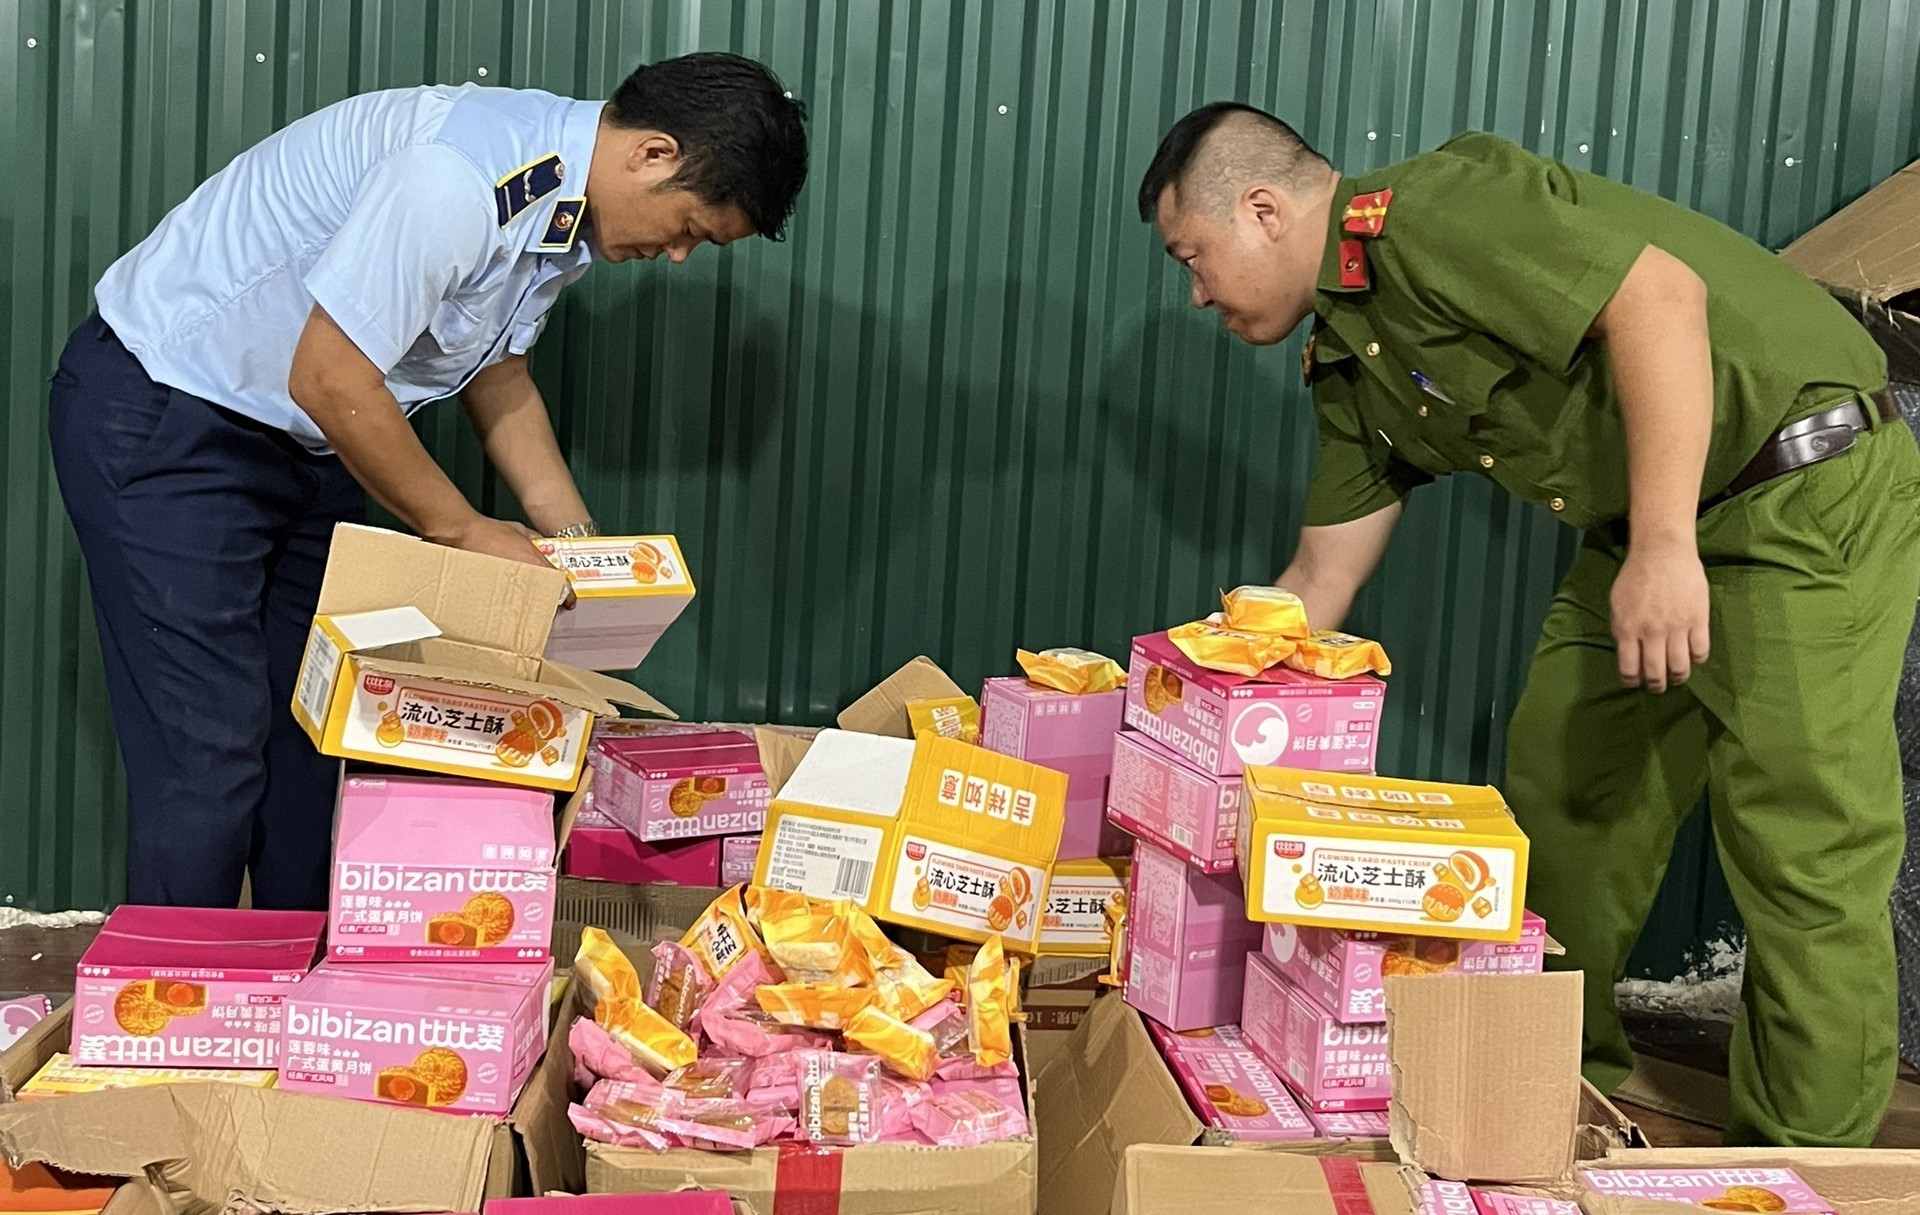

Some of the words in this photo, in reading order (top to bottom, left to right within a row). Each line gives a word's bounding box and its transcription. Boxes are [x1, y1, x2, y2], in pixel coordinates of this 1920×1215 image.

[566, 555, 630, 568] 流心芝士酥
[401, 701, 505, 735] 流心芝士酥
[464, 702, 487, 711] PASTE
[489, 705, 512, 714] CRISP
[1163, 717, 1218, 774] bibizan
[941, 774, 1031, 821] 吉祥如意
[1318, 853, 1355, 863] FLOWING
[1381, 858, 1406, 866] PASTE
[1408, 860, 1432, 868] CRISP
[340, 863, 464, 893] bibizan
[929, 867, 996, 900] 流心芝士酥
[1317, 863, 1427, 889] 流心芝士酥
[338, 909, 423, 924] 广式蛋黄月饼
[287, 1004, 414, 1045] bibizan
[419, 1017, 505, 1053] 比比赞
[171, 1036, 280, 1065] ibizan
[287, 1056, 372, 1077] 广式蛋黄月饼
[1586, 1171, 1714, 1189] bibizan
